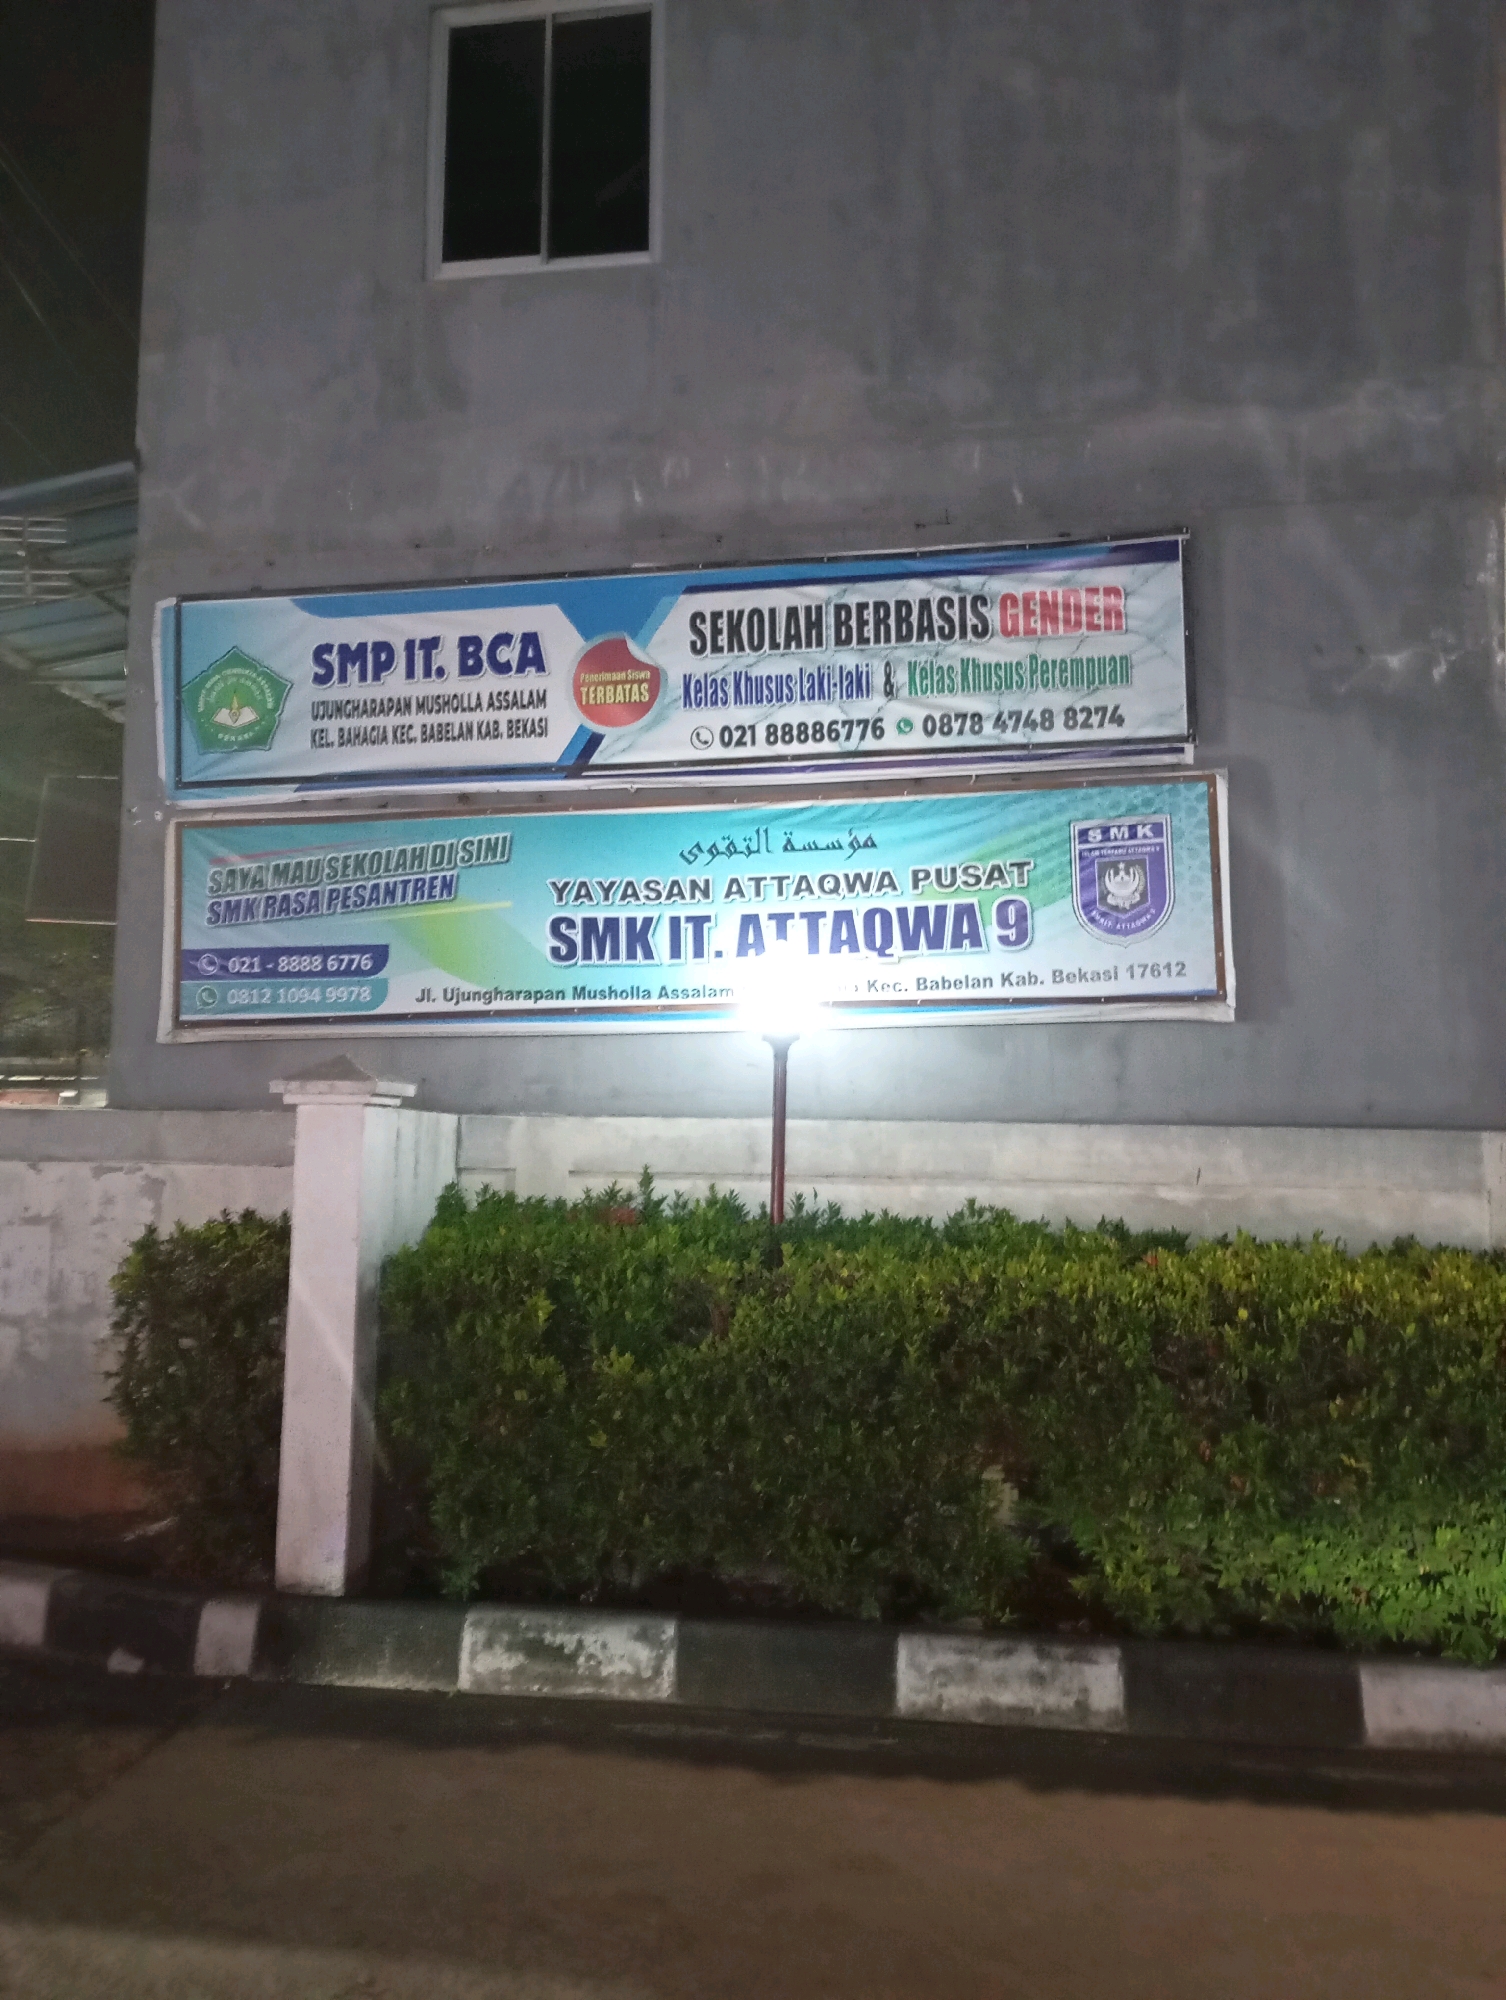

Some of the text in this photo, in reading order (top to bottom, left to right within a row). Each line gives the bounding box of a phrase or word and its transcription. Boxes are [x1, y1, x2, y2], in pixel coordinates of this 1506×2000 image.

[689, 586, 1125, 656] SEKOLAH BERBASIS GENDER
[311, 631, 547, 686] SMP IT. BCA
[580, 669, 651, 683] Penerimaan Siswa
[580, 682, 650, 705] TERBATAS
[682, 653, 1130, 709] Kelas Khusus Laki-laki & Kelas Khusus Perempuan
[311, 689, 547, 721] UJUNGHARAPAN MUSHOLLA ASSALAM
[310, 717, 548, 749] KEL. BAHAGIA KEC. BABELAN KAB. BEKASI
[719, 704, 1125, 748] 021 88886776 0878 4748 8274
[679, 826, 878, 867] مؤسسة التقوى
[1087, 824, 1154, 843] SMK
[208, 833, 512, 895] SAYA MAU SEKOLAH DI SINI
[207, 872, 458, 926] SMK RASA PESANTREN
[549, 861, 1033, 905] YAYASAN ATTAQWA PUSAT
[548, 898, 1030, 962] SMK IT. ATTAQWA 9
[227, 955, 261, 974] 021
[277, 954, 324, 973] 8888
[326, 953, 374, 972] 6776
[867, 978, 908, 994] Kec.
[915, 974, 994, 992] Babelan
[1001, 970, 1044, 988] Kab.
[1051, 963, 1120, 985] Bekasi
[1125, 960, 1187, 981] 17612
[227, 988, 272, 1005] 0812
[325, 985, 372, 1003] 9978
[415, 983, 735, 1006] Jl. Ujungharapan Musholla Assalam
